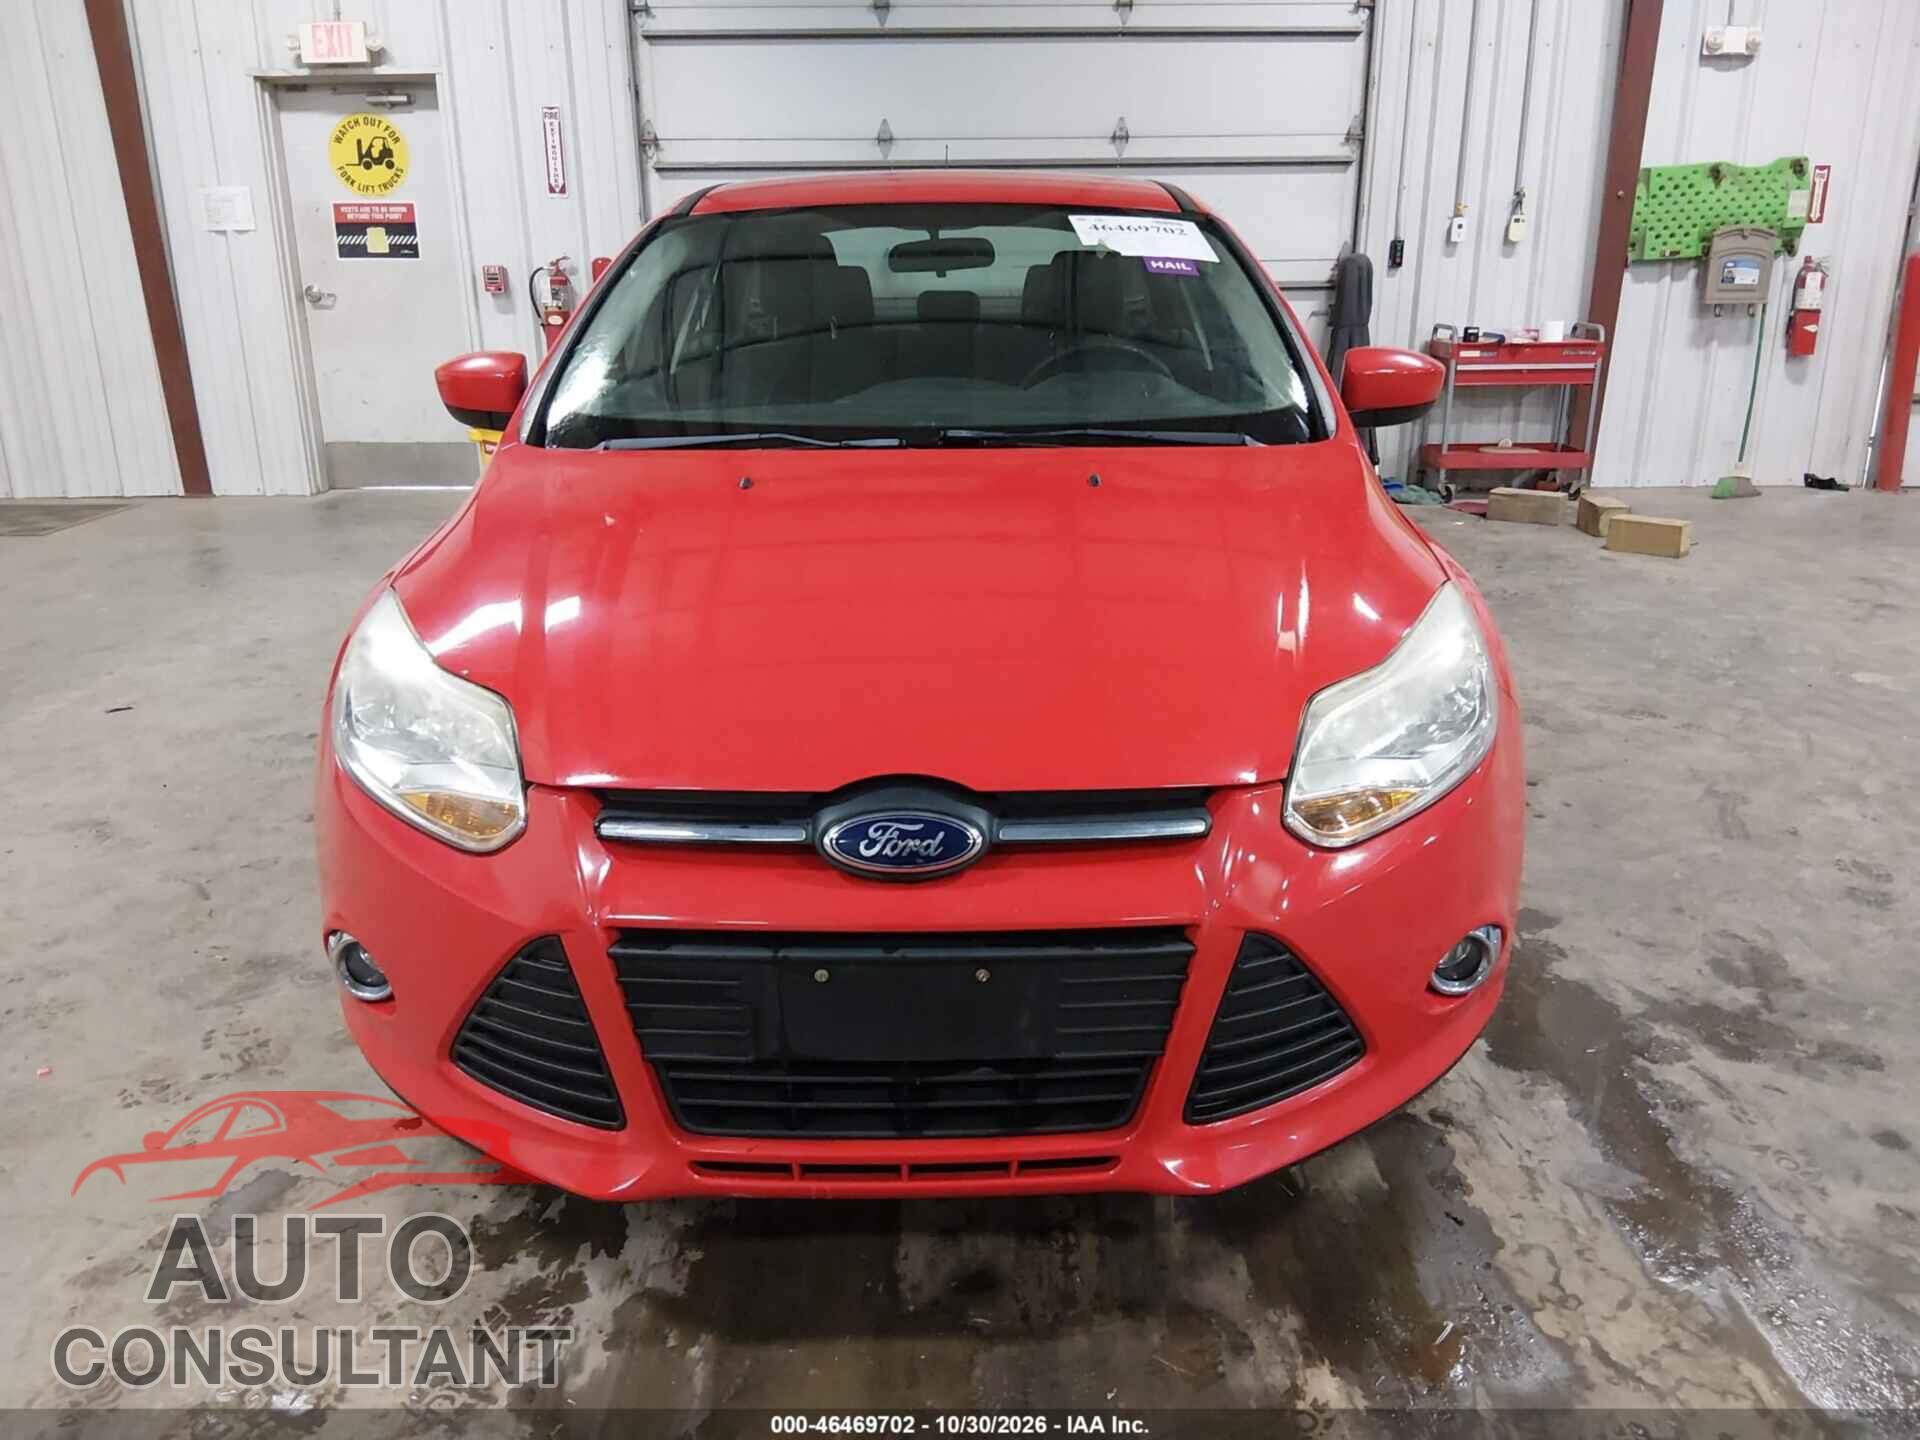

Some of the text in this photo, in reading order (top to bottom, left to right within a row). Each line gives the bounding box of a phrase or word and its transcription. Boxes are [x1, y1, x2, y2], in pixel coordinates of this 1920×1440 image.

[312, 23, 352, 58] EXIT
[544, 112, 560, 120] FIRE
[334, 117, 401, 145] WATCH OUT FOR
[337, 166, 404, 193] FORK LIFT TRUCKS
[1088, 224, 1189, 236] 46469702
[1151, 260, 1192, 271] HAIL
[859, 821, 945, 858] Ford
